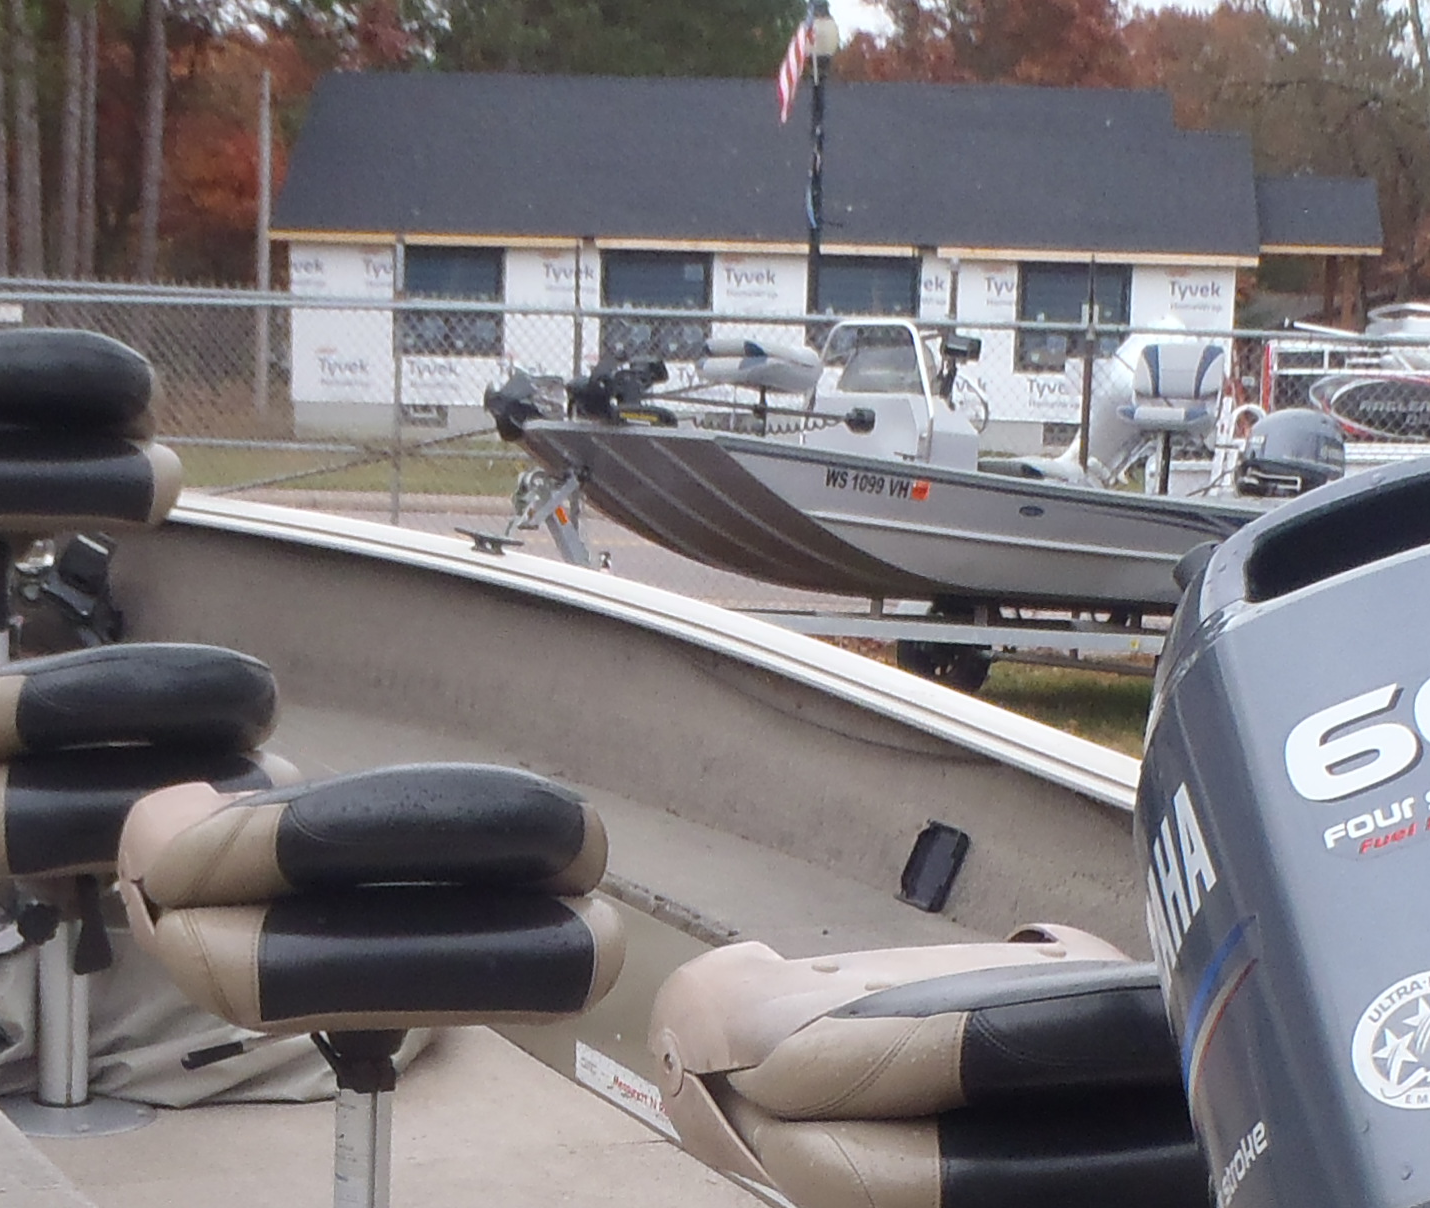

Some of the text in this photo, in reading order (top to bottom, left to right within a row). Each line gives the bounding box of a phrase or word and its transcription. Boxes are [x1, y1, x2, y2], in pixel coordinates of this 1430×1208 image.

[725, 266, 777, 288] Tyvek
[985, 276, 1015, 297] Tyv
[1170, 280, 1221, 301] Tyvek
[826, 468, 910, 499] WS 1099 VH
[1358, 822, 1417, 855] Fuel
